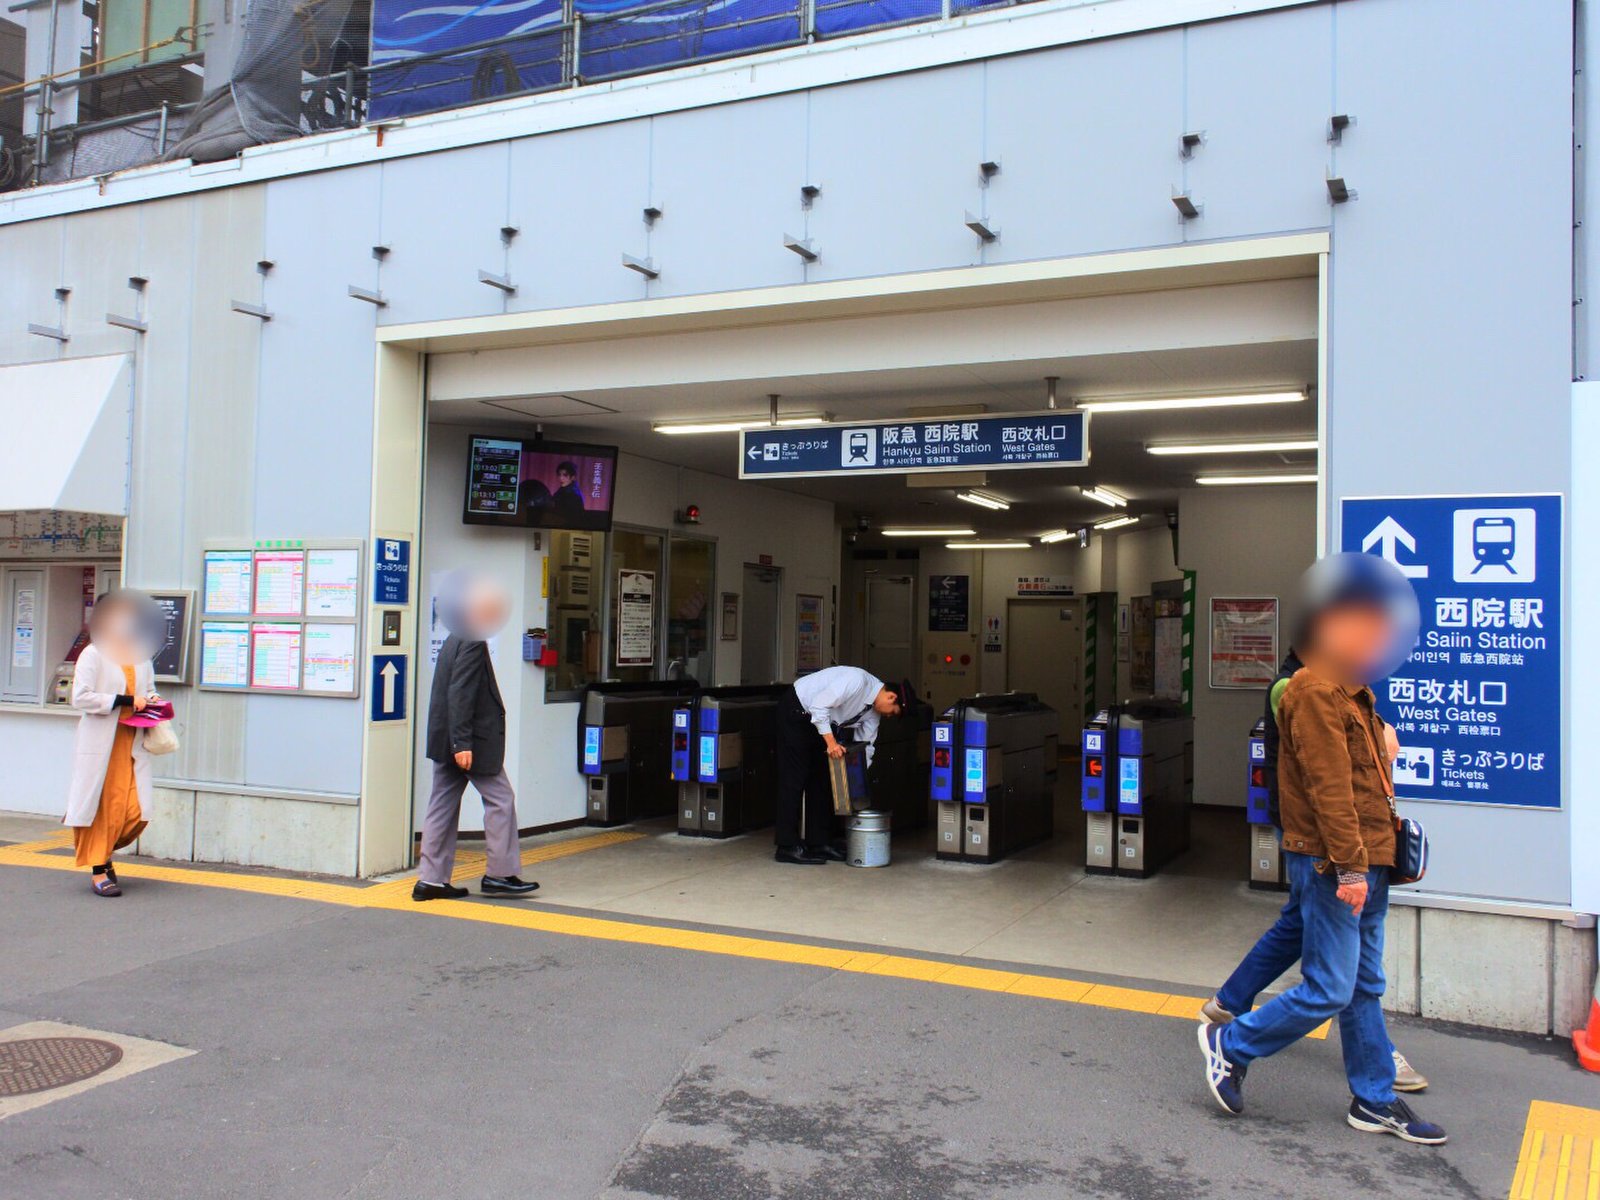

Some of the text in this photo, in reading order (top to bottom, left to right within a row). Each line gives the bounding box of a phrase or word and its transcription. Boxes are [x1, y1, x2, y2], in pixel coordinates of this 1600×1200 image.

[882, 423, 978, 444] 阪急 西院駅
[1002, 425, 1066, 442] 西改札口
[782, 440, 829, 450] きっぷうりば
[882, 443, 992, 457] Hankyu Saiin Station
[1002, 442, 1056, 452] West Gates
[1435, 598, 1544, 628] 西院駅
[1426, 631, 1471, 648] Saiin
[1478, 632, 1546, 650] Station
[1460, 652, 1524, 666] 阪急西院站
[1388, 678, 1507, 706] 西改札口
[1398, 706, 1498, 722] West Gates
[938, 730, 945, 740] 3
[1395, 722, 1450, 734] 서쪽 개찰구
[1088, 737, 1097, 748] 4
[1256, 746, 1264, 756] 5
[1442, 748, 1545, 770] きっぷうりば
[1440, 768, 1485, 780] Tickets
